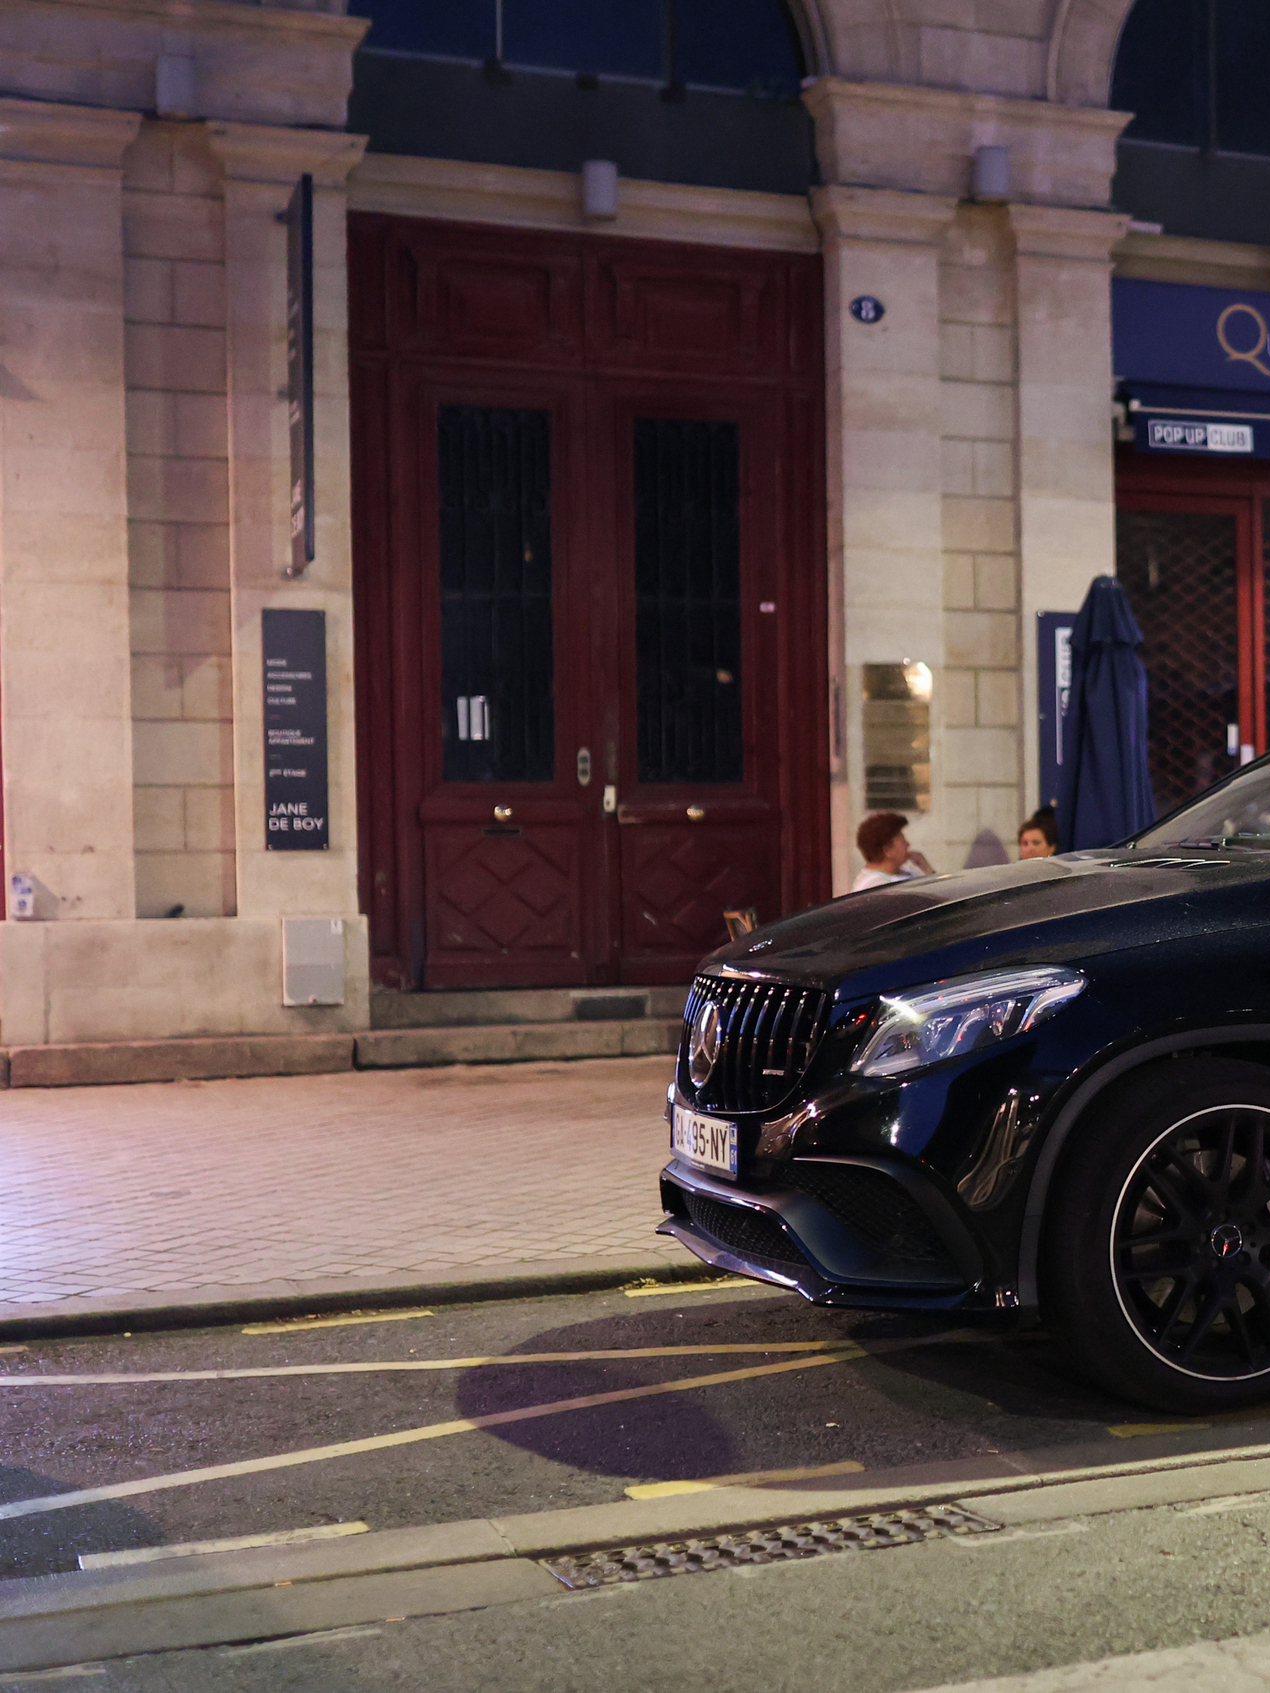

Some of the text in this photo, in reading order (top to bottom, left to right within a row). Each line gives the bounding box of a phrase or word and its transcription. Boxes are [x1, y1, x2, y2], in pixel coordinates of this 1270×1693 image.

[1154, 425, 1246, 447] POP UP CLUB
[269, 802, 308, 815] JANE
[268, 817, 324, 831] DE BOY
